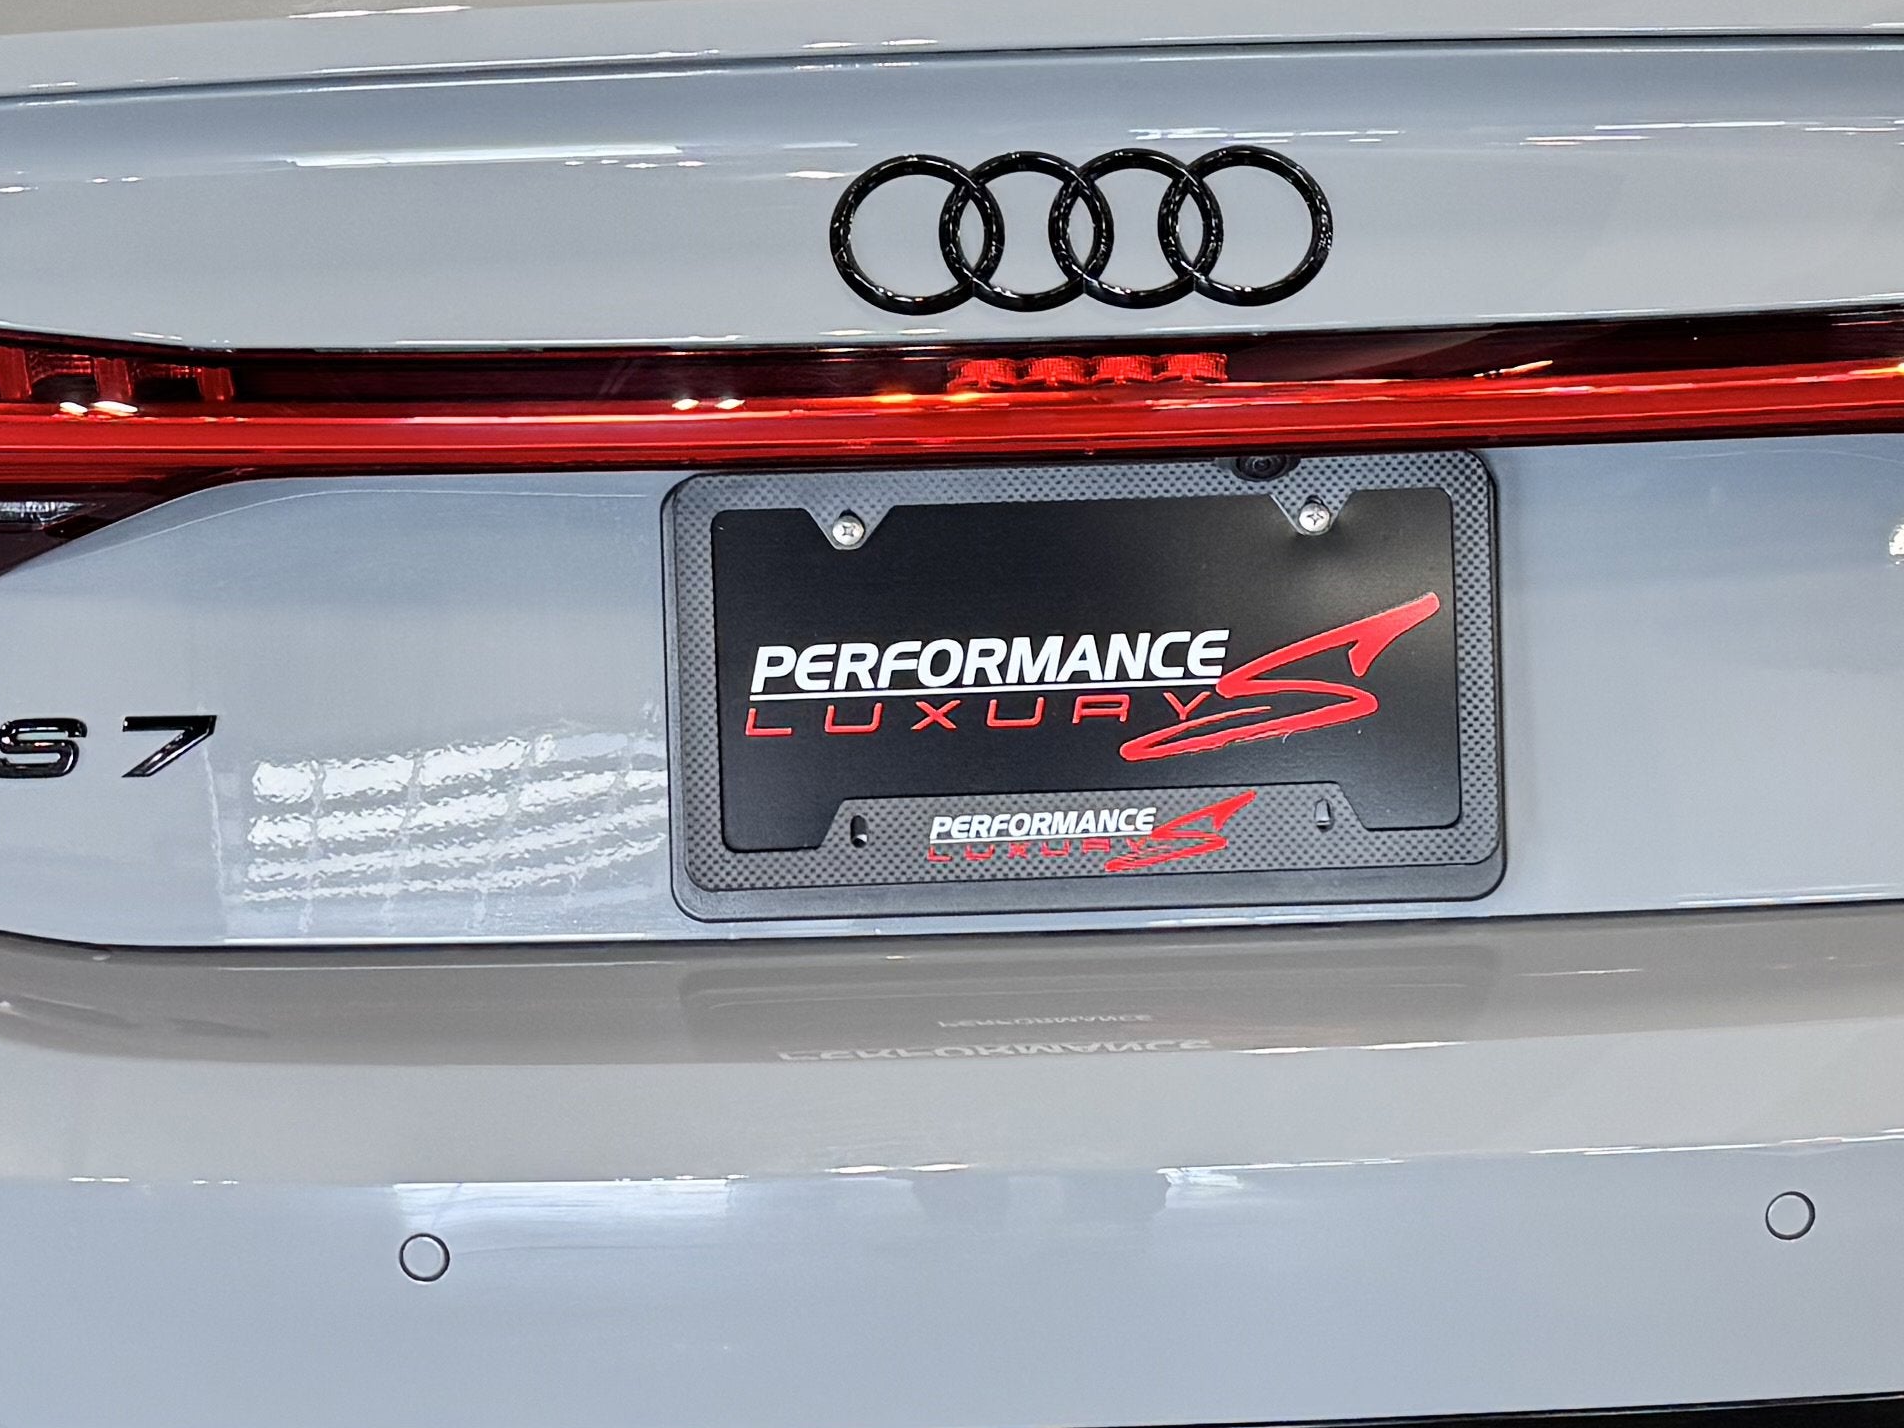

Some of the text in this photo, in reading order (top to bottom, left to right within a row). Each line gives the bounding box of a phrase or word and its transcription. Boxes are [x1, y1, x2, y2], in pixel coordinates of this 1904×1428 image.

[751, 629, 1230, 694] PERFORMANCE
[744, 691, 1214, 737] LUXURY
[122, 715, 217, 778] 7
[929, 807, 1157, 841] PERFORMANCE
[926, 837, 1151, 863] LUXURY
